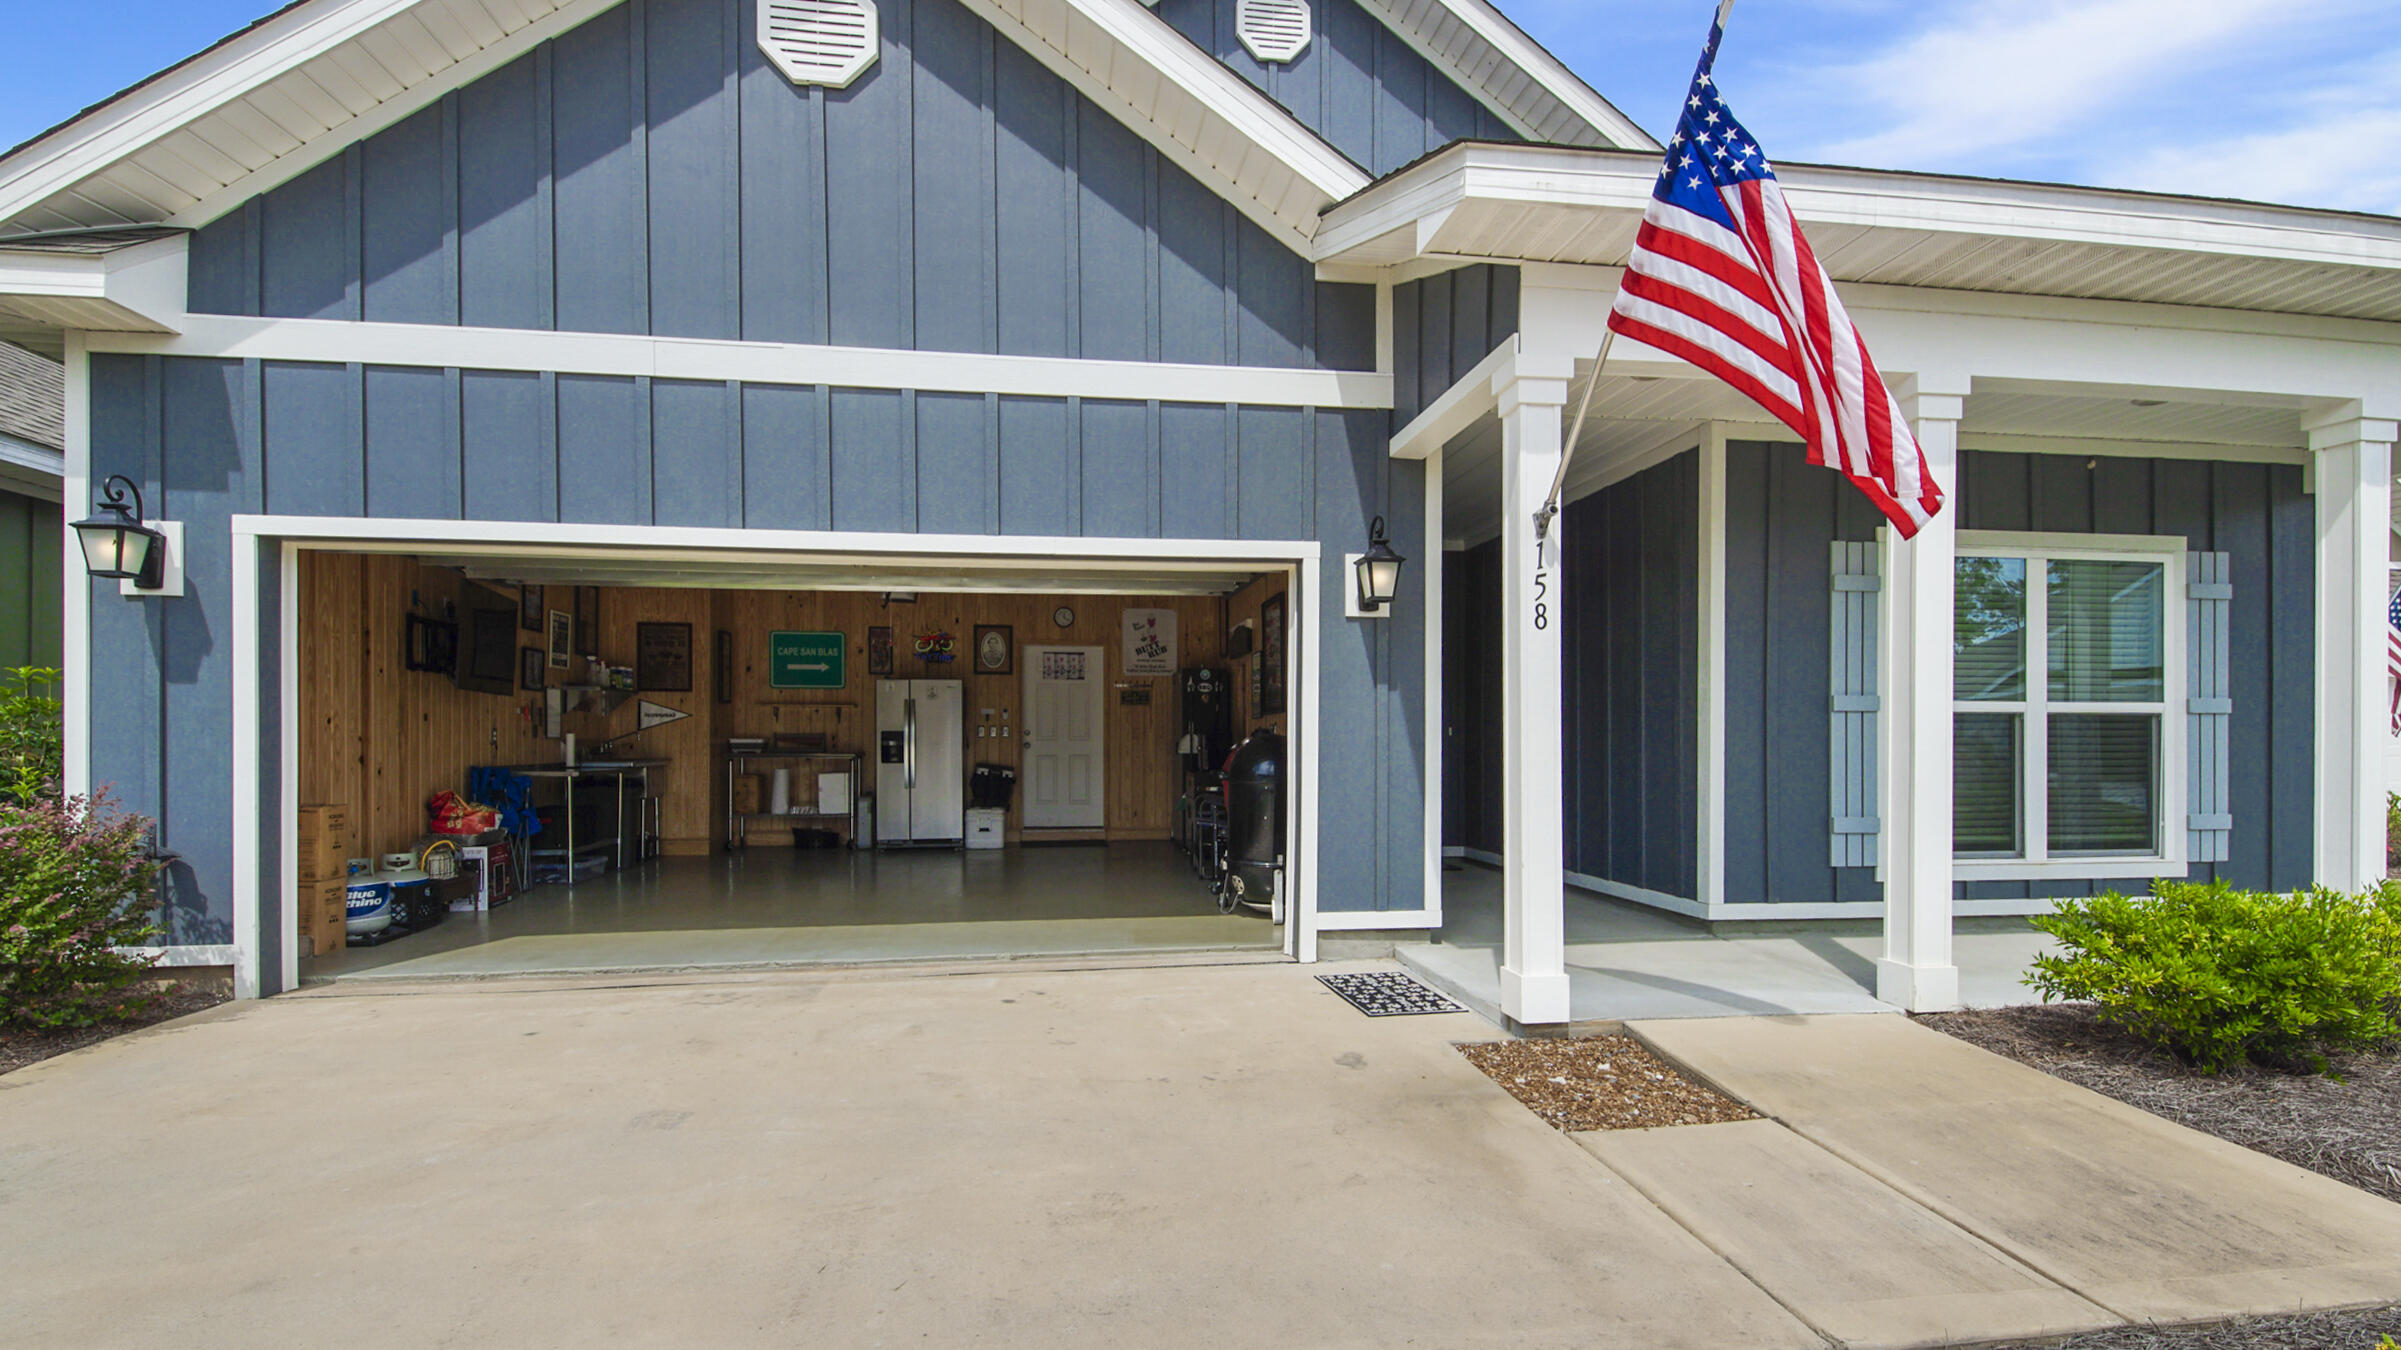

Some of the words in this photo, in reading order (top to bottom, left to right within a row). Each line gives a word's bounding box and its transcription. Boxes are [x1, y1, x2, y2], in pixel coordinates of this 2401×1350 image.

[1535, 541, 1548, 631] 158
[776, 647, 799, 657] CAPE
[800, 647, 817, 657] SAN
